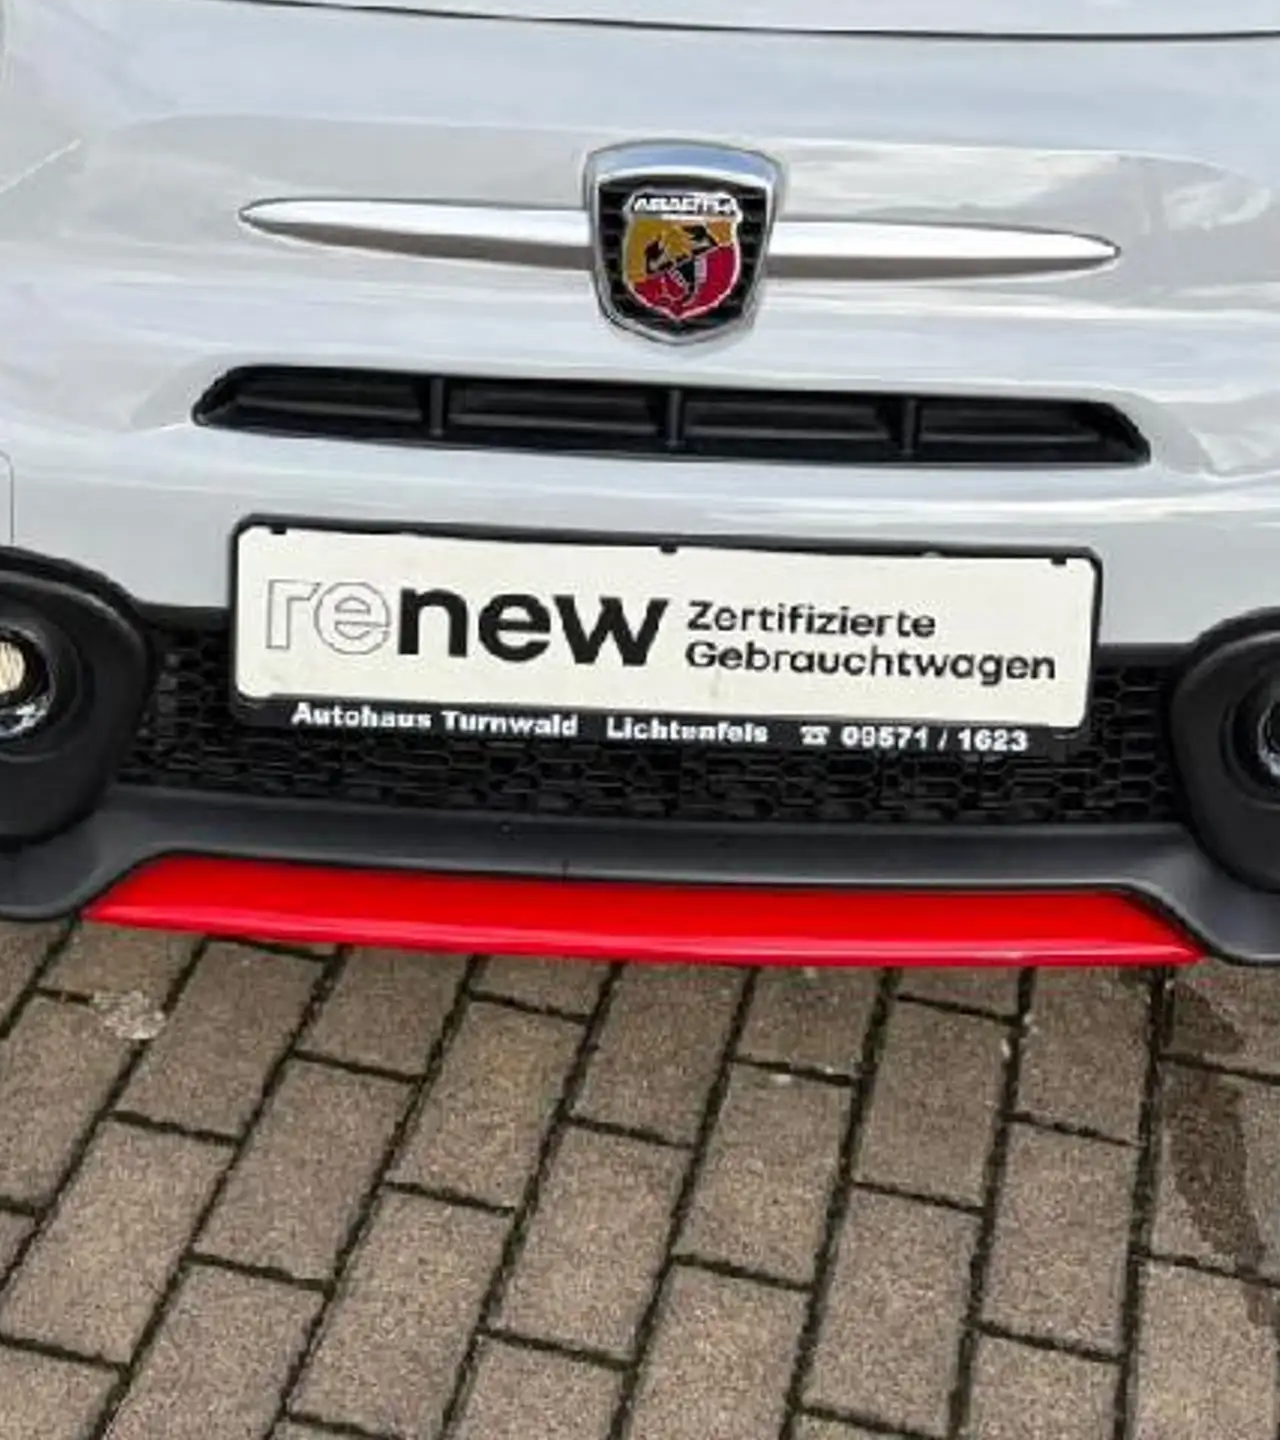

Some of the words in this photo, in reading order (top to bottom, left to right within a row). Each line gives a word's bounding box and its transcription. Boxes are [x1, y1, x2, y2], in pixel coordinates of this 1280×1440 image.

[265, 578, 670, 668] renew
[686, 600, 937, 638] Zertifizierte
[684, 641, 1056, 686] Gebrauchtwagen
[291, 702, 432, 730] Autohaus
[441, 710, 579, 737] Turnwald
[606, 716, 769, 744] Lichtenfels
[840, 725, 928, 751] 09571
[957, 728, 1030, 753] 1623
